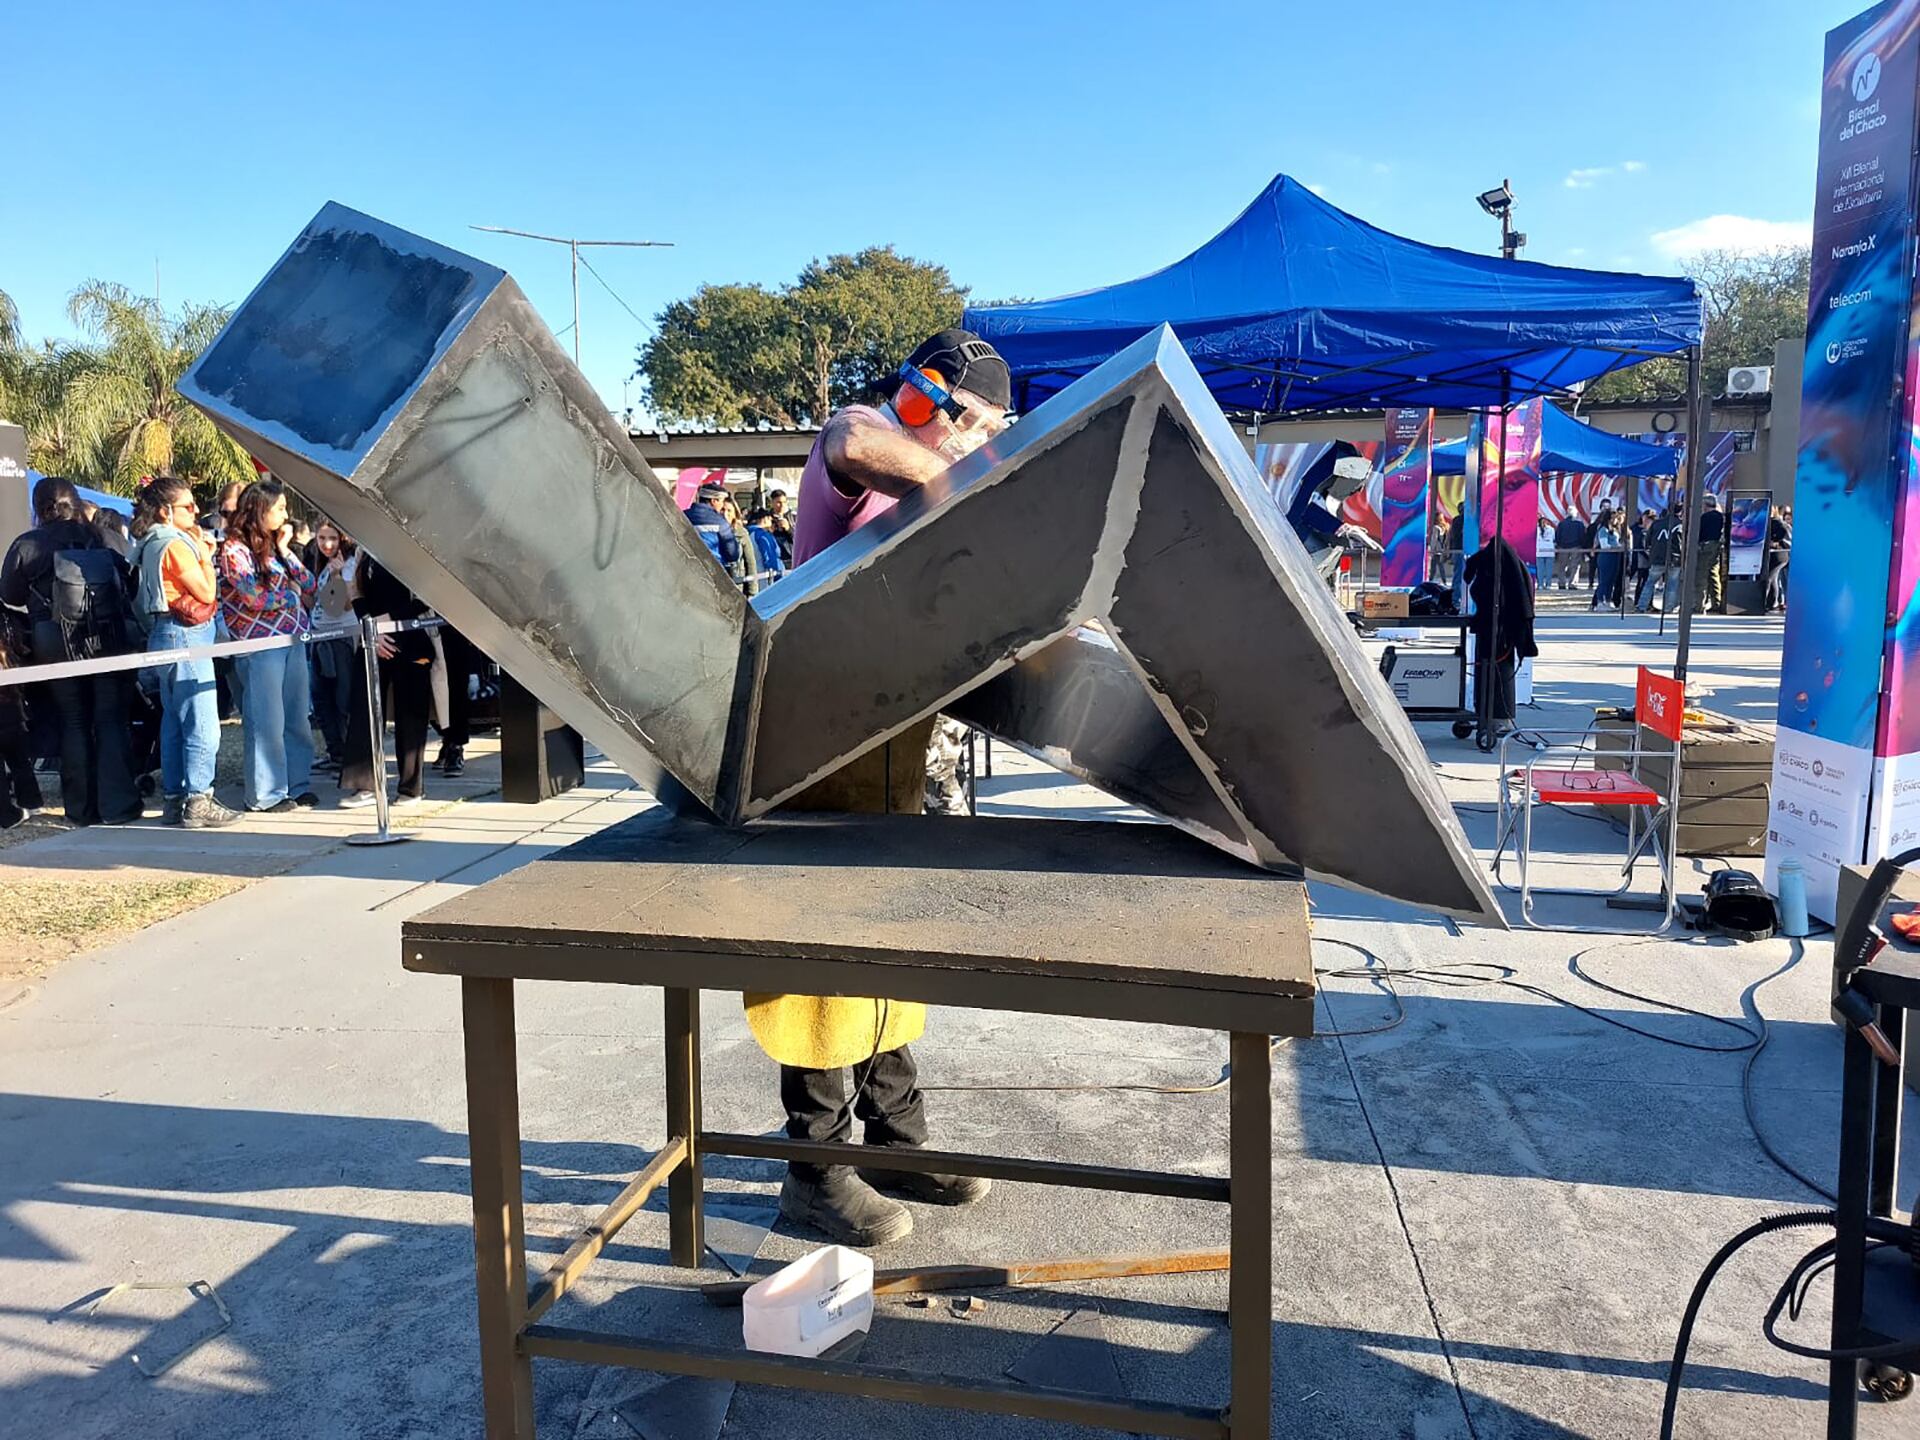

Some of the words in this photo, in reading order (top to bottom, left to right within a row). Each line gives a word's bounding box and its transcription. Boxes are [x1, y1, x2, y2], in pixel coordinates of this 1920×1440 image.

[1848, 99, 1880, 124] Bienal
[1840, 124, 1854, 141] del
[1855, 114, 1887, 135] Chaco
[1853, 156, 1879, 177] Bienal
[1829, 289, 1872, 309] telecom
